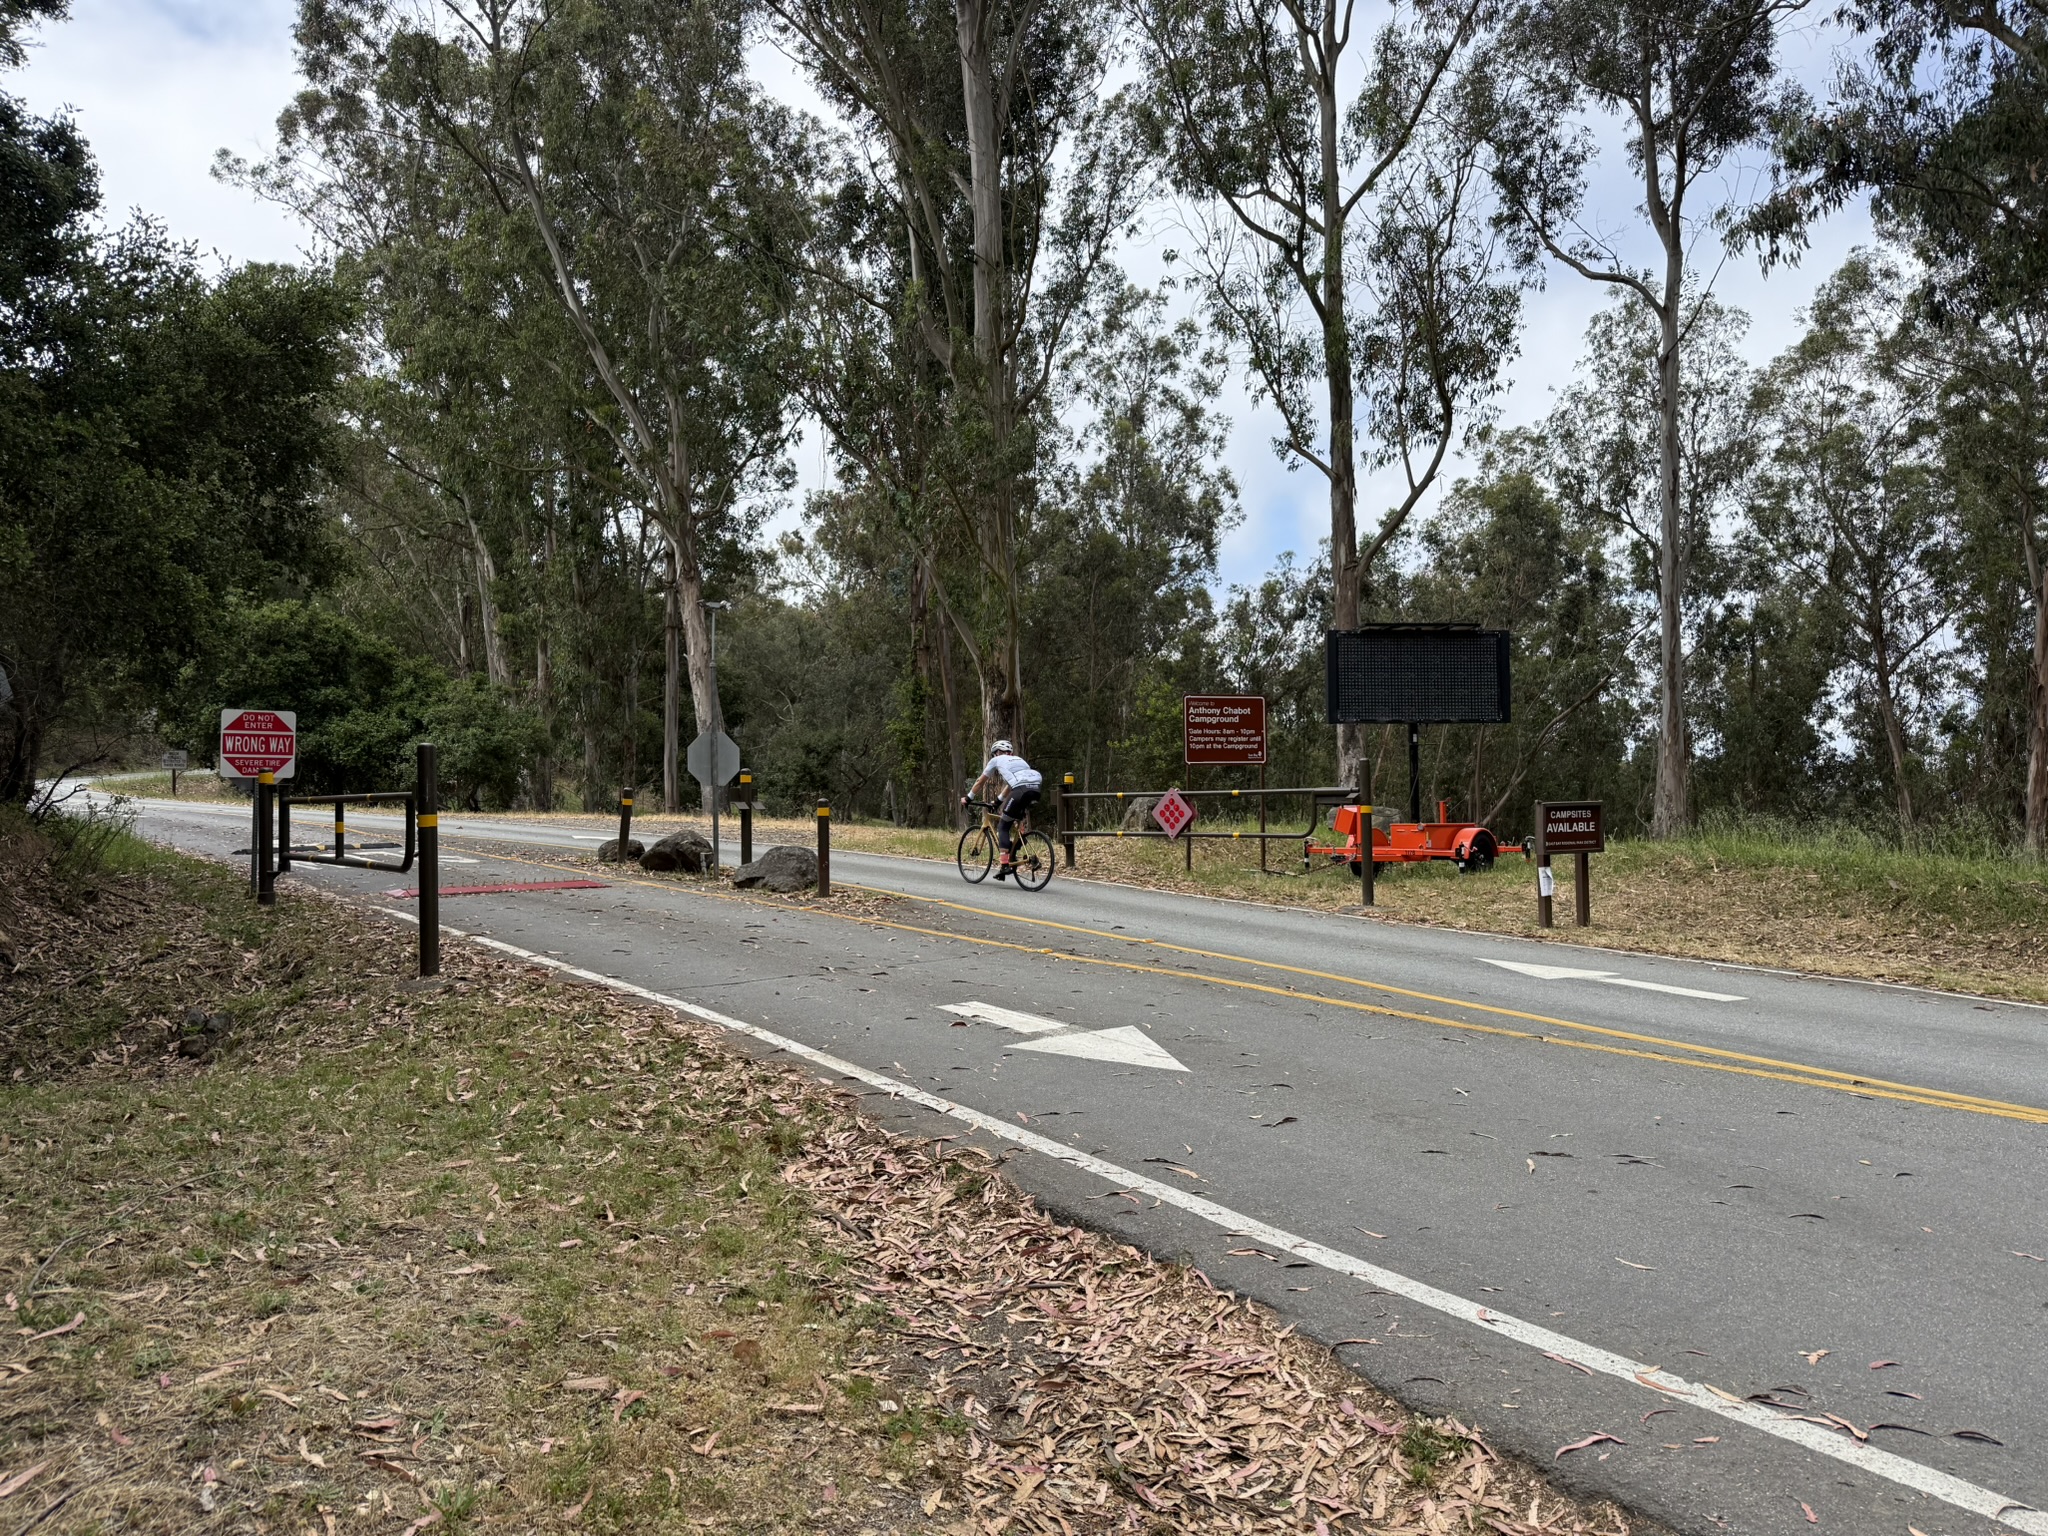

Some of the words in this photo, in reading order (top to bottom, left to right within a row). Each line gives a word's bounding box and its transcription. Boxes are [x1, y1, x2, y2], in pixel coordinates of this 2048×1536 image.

[1189, 706, 1221, 715] Anthony
[258, 714, 275, 722] NOT
[1189, 715, 1239, 724] Campground
[225, 735, 266, 752] WRONG
[269, 737, 291, 752] WAY
[1550, 810, 1591, 819] CAMPSITES
[1546, 822, 1595, 833] AVAILABLE
